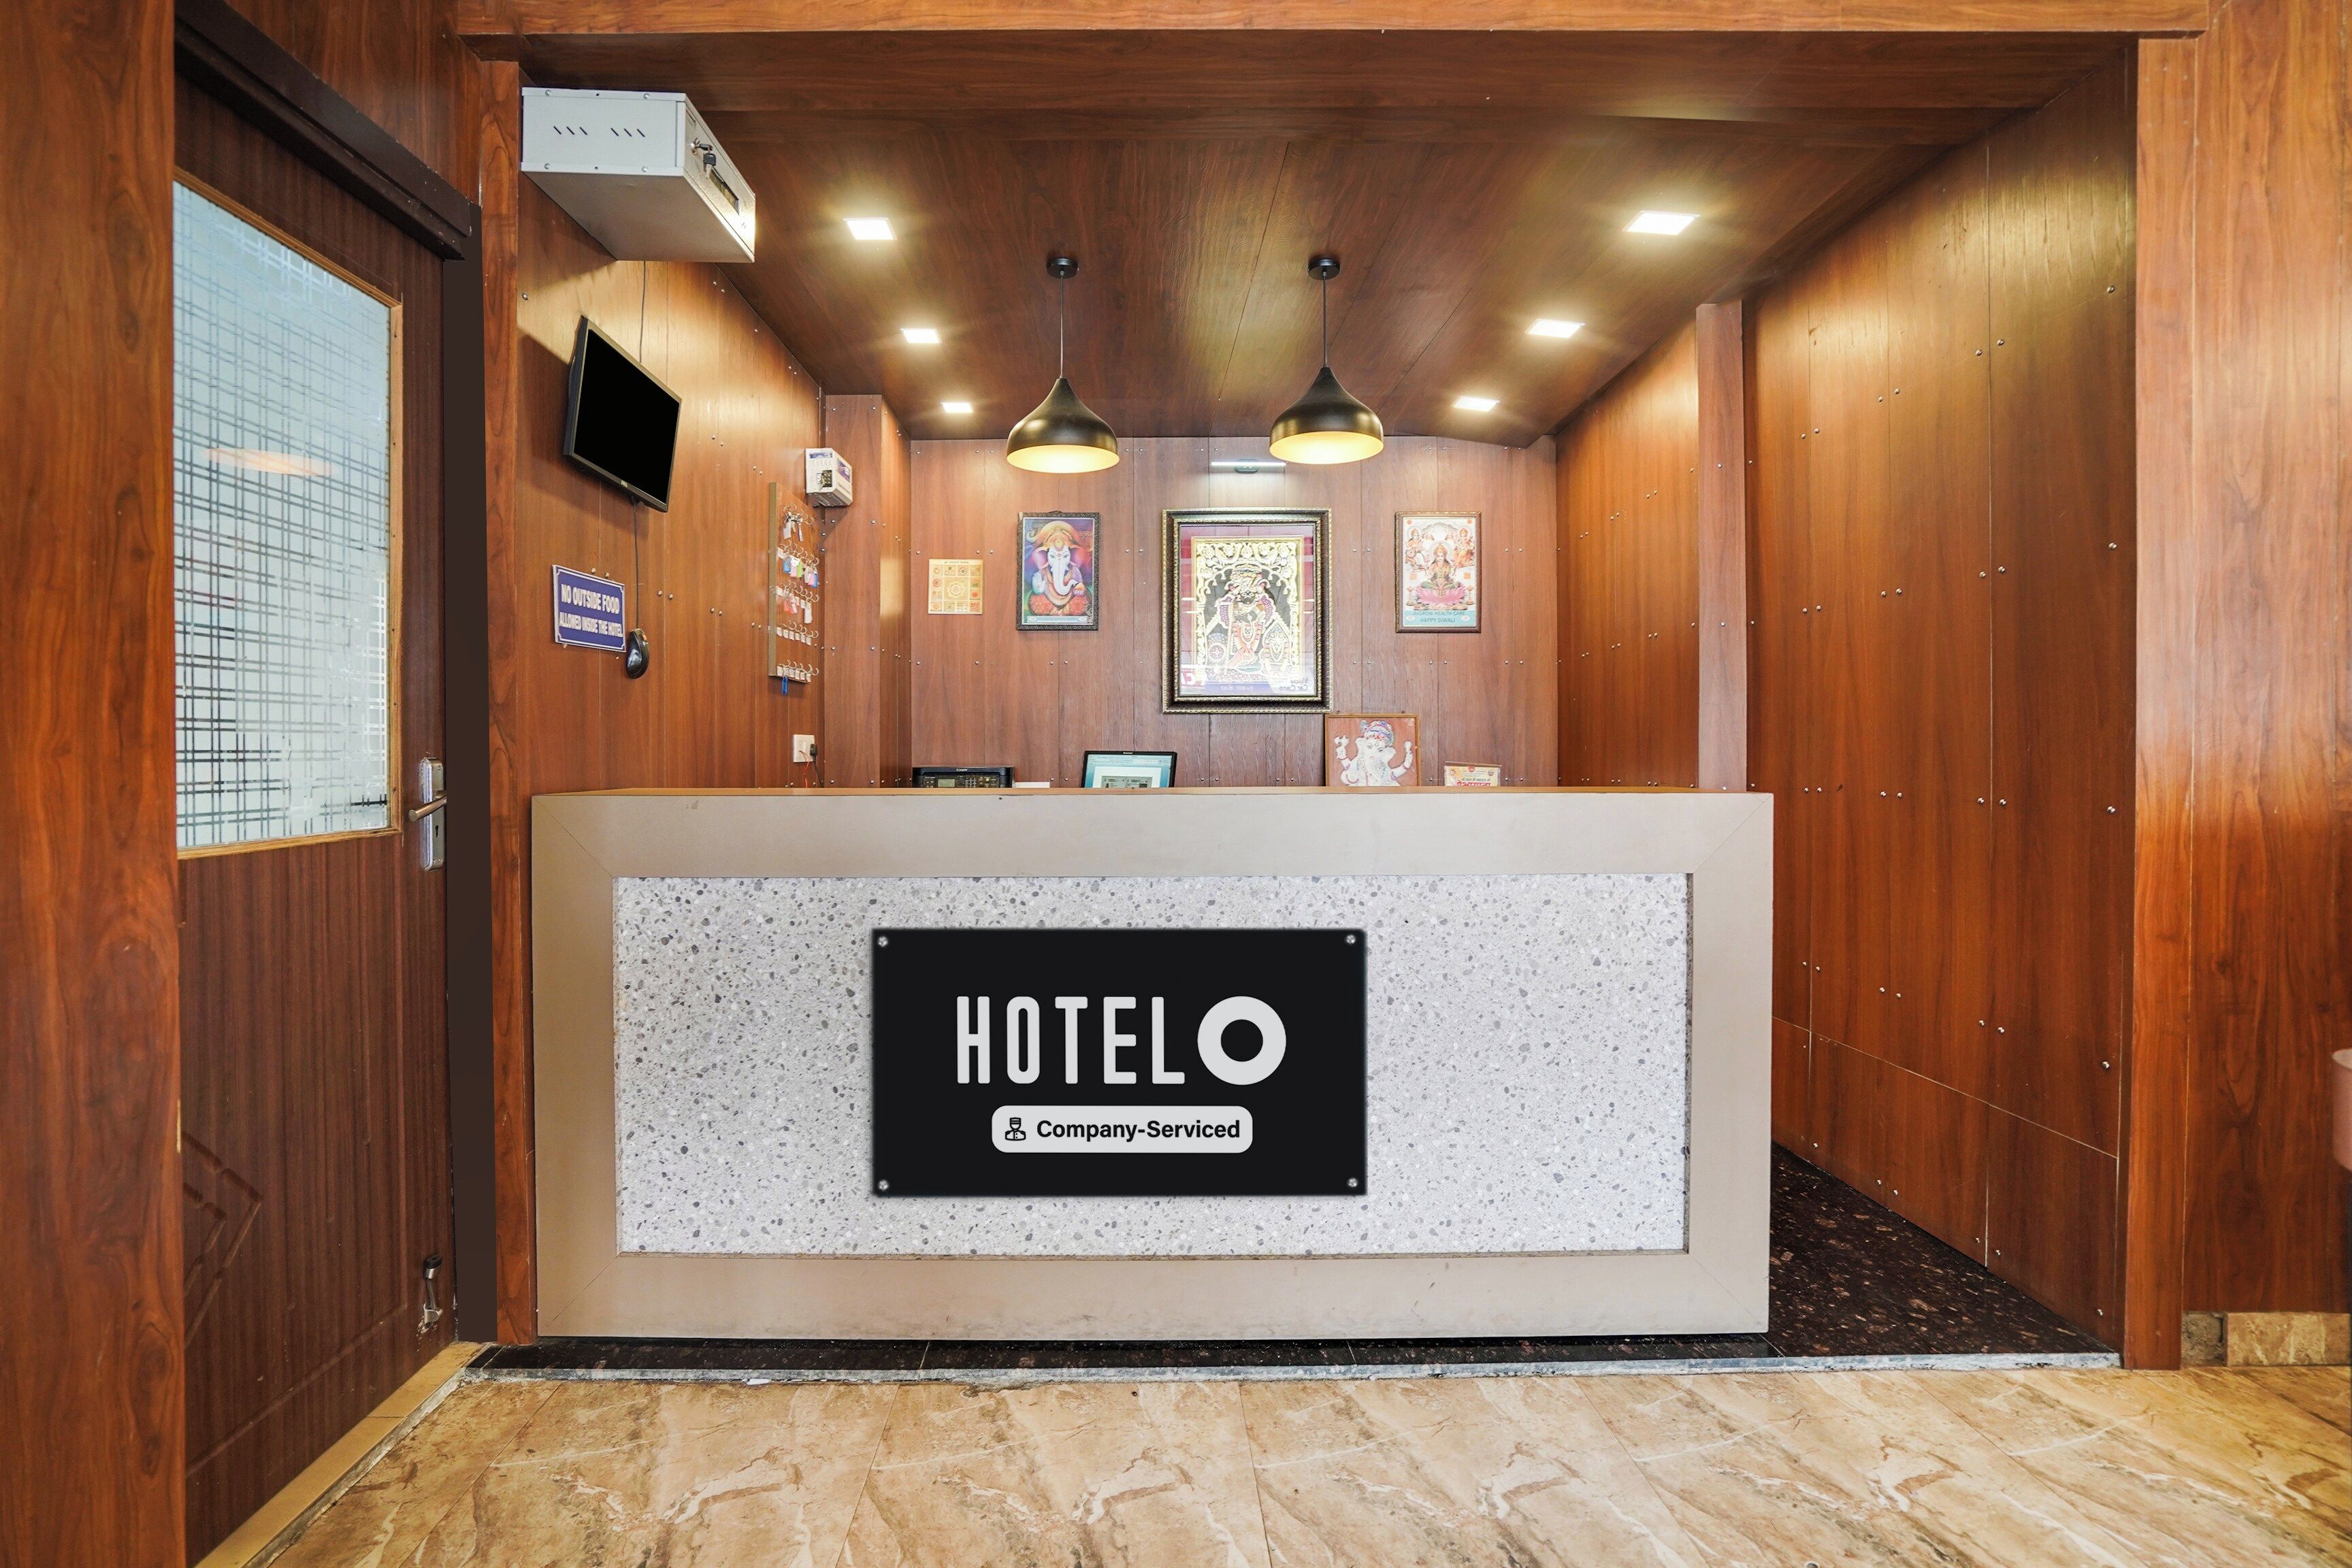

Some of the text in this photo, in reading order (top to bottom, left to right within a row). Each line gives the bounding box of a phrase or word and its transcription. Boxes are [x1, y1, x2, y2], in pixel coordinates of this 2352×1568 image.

[561, 584, 620, 615] NO OUTSIDE FOOD
[559, 611, 623, 638] ALLOWED INSIDE THE HOTEL
[956, 996, 1186, 1085] HOTEL
[1036, 1120, 1241, 1143] Company-Serviced
